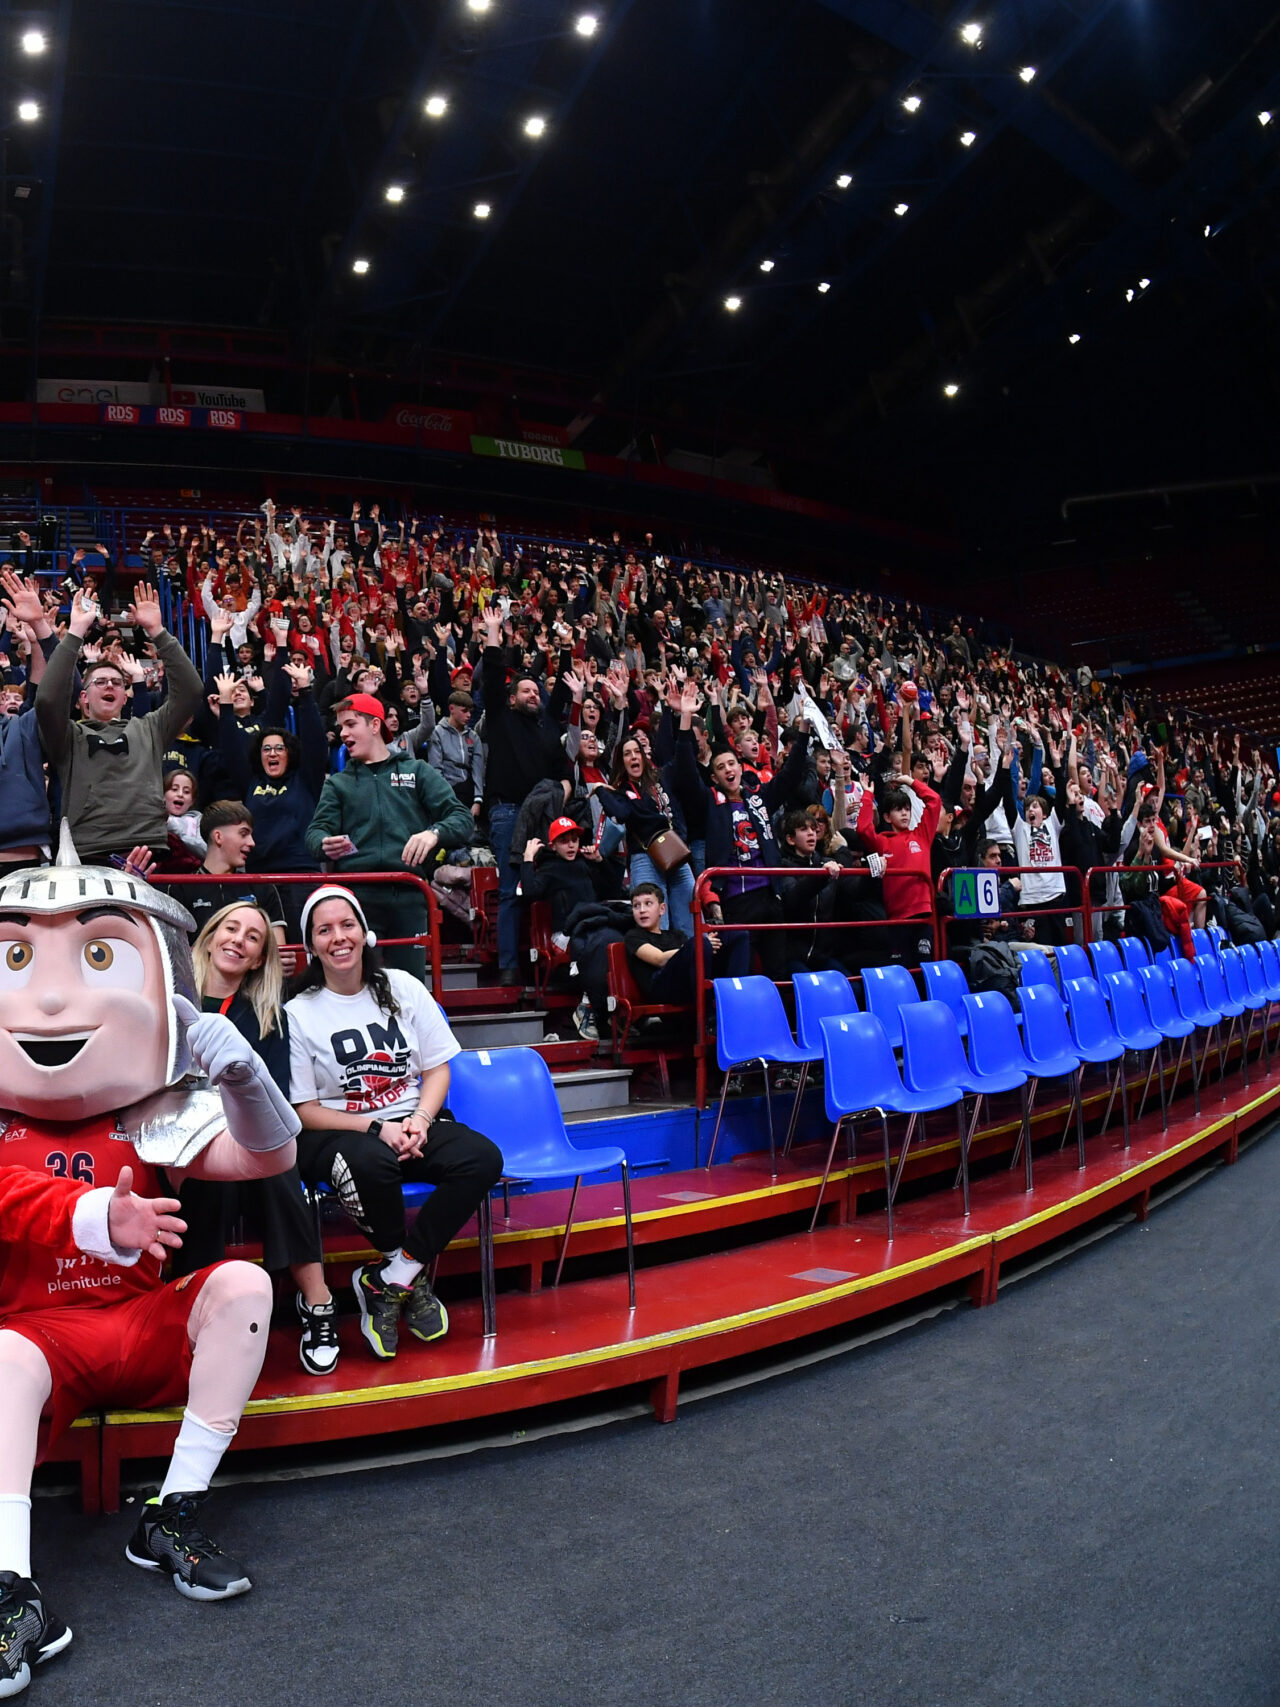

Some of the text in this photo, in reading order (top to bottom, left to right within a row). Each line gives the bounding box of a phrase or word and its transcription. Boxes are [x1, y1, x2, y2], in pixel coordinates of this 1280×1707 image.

[57, 385, 119, 402] enel
[199, 392, 246, 408] YouTube
[108, 406, 134, 420] RDS
[159, 408, 185, 422] RDS
[210, 411, 236, 425] RDS
[494, 439, 564, 465] TUBORG
[391, 772, 416, 781] NASA
[959, 879, 993, 908] A 6
[331, 1015, 408, 1066] OM
[5, 1128, 27, 1141] EA7
[45, 1151, 95, 1186] 36
[47, 1273, 122, 1294] plenitude
